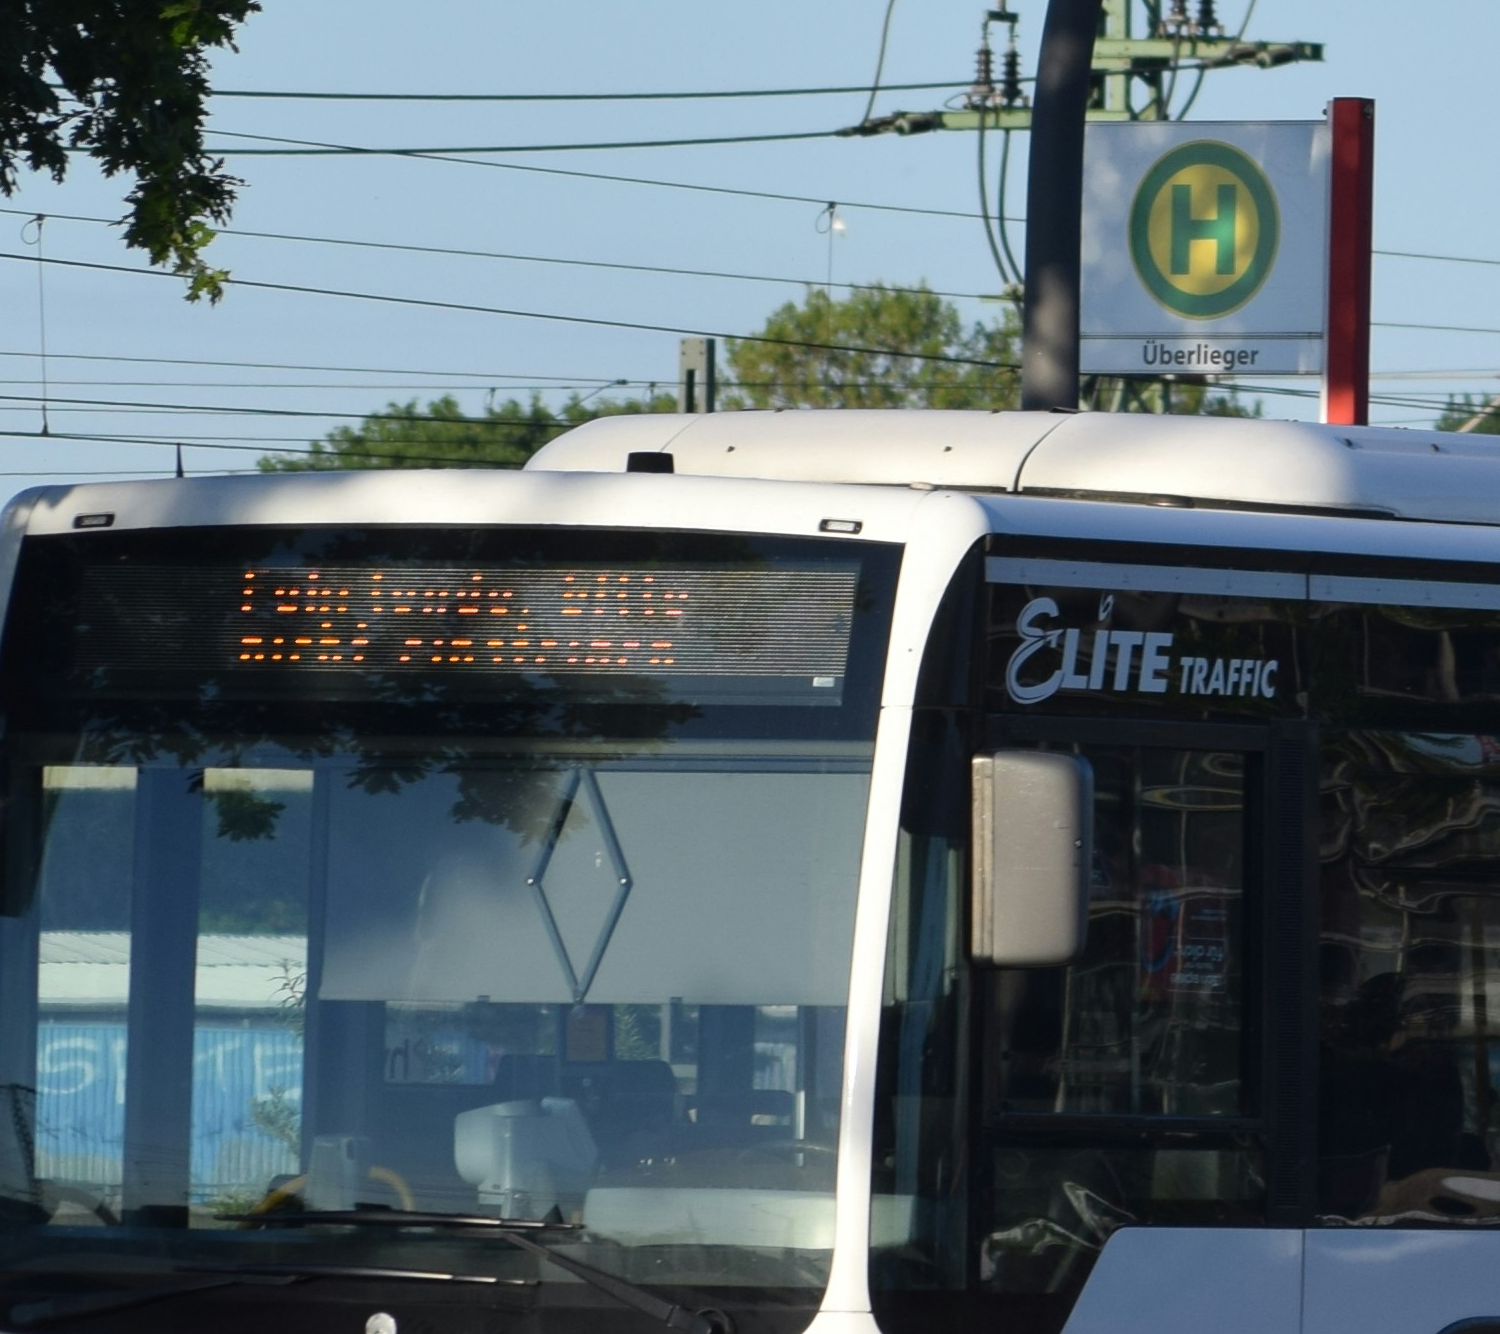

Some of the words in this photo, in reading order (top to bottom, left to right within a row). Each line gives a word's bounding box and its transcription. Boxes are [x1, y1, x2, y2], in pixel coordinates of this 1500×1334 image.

[1169, 183, 1237, 275] H
[1142, 340, 1259, 370] Überlieger
[1179, 656, 1280, 699] TRAFFIC
